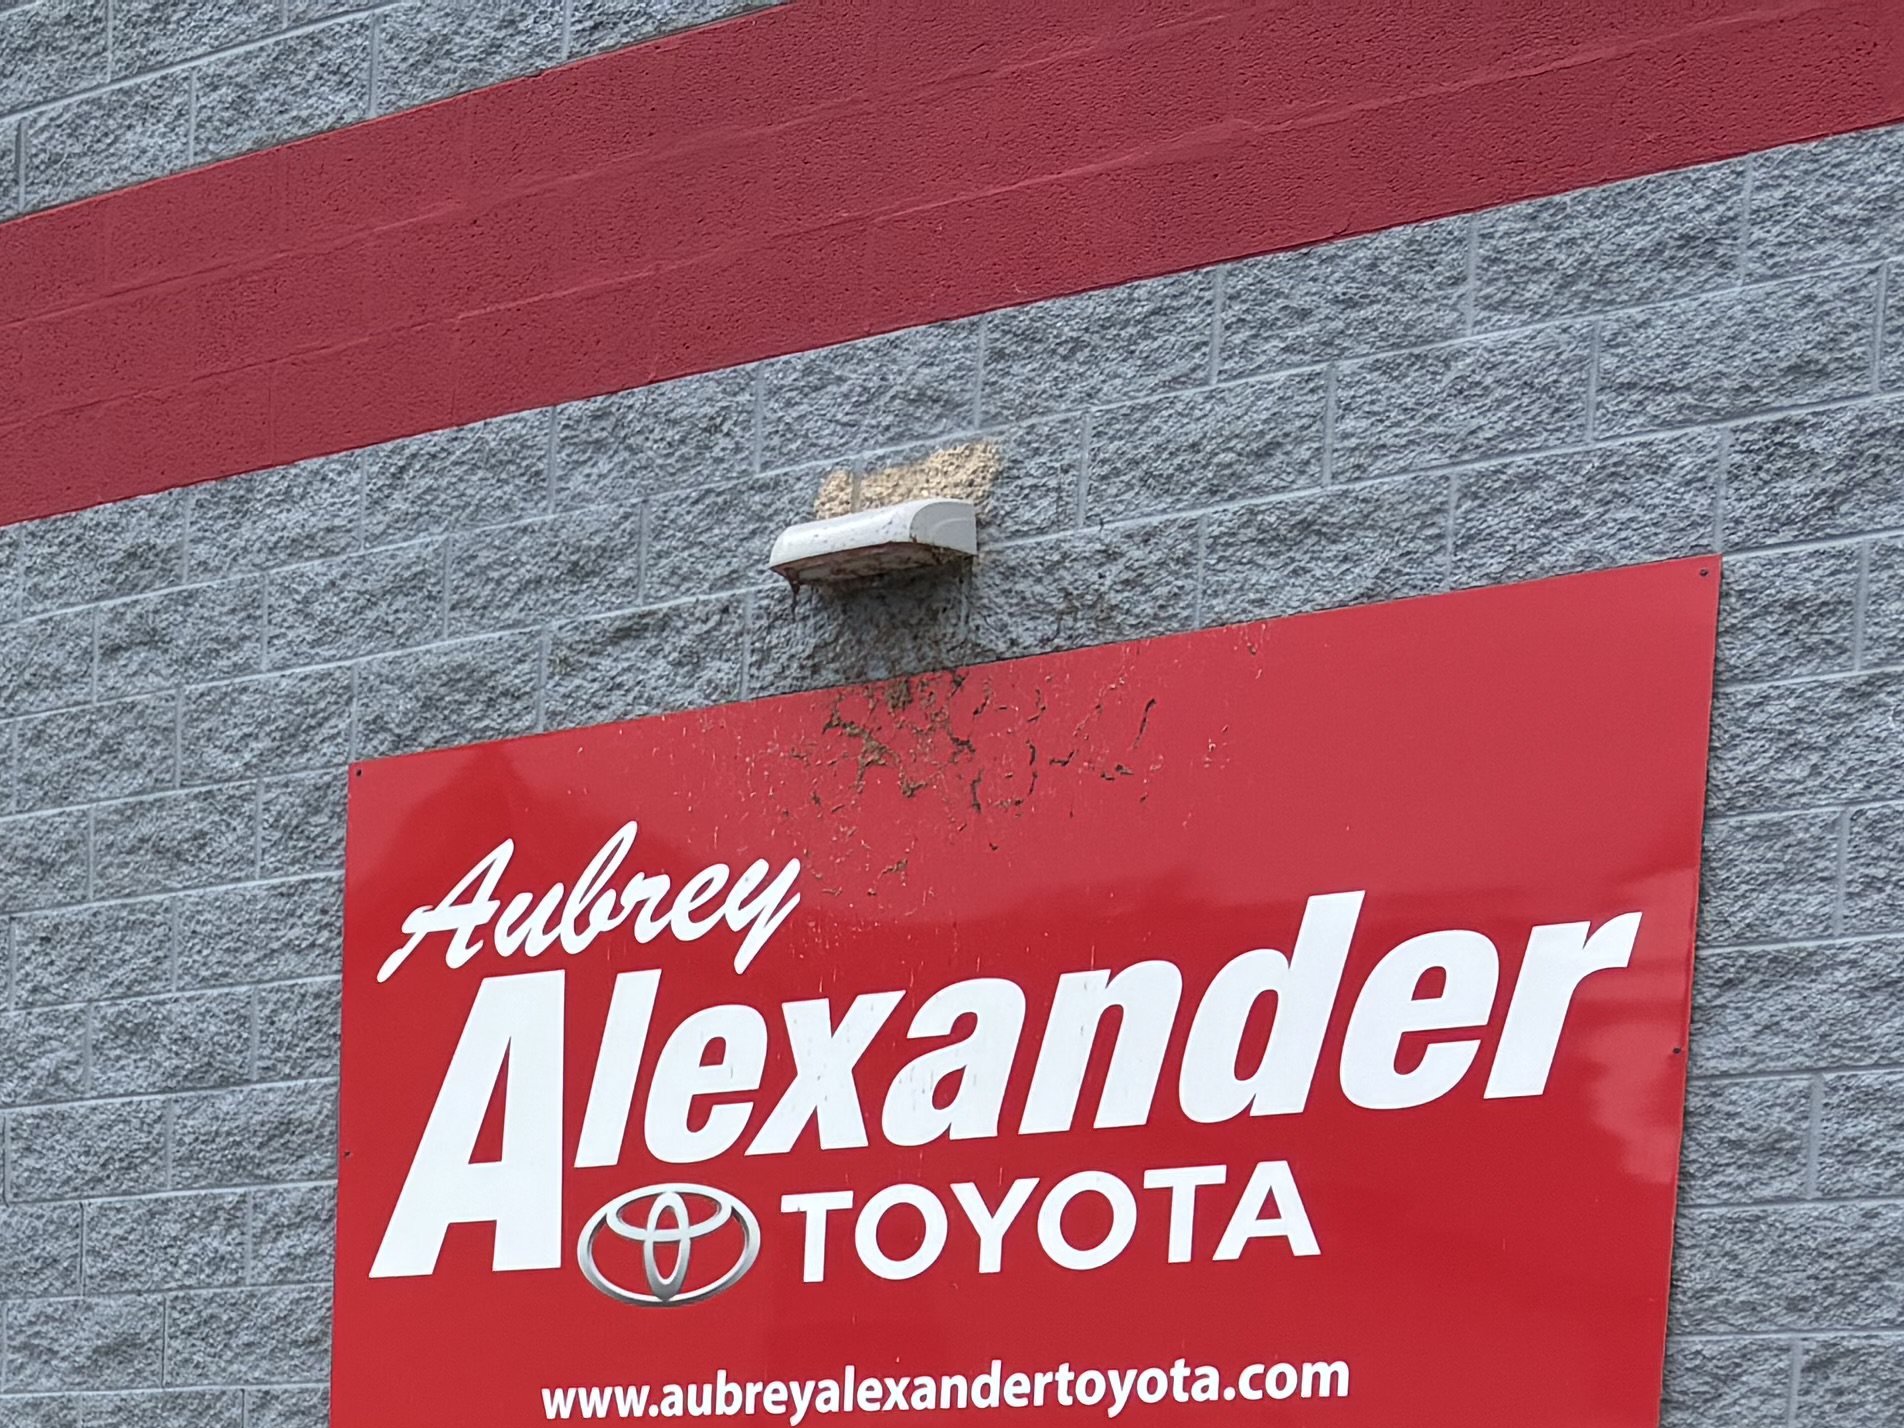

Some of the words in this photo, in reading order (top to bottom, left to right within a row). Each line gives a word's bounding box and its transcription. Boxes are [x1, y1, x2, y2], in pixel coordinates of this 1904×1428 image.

[376, 820, 801, 983] Aubrey
[368, 890, 1643, 1280] Alexander
[779, 1160, 1322, 1284] TOYOTA
[541, 1358, 1351, 1427] www.aubreyalexandertoyota.com
